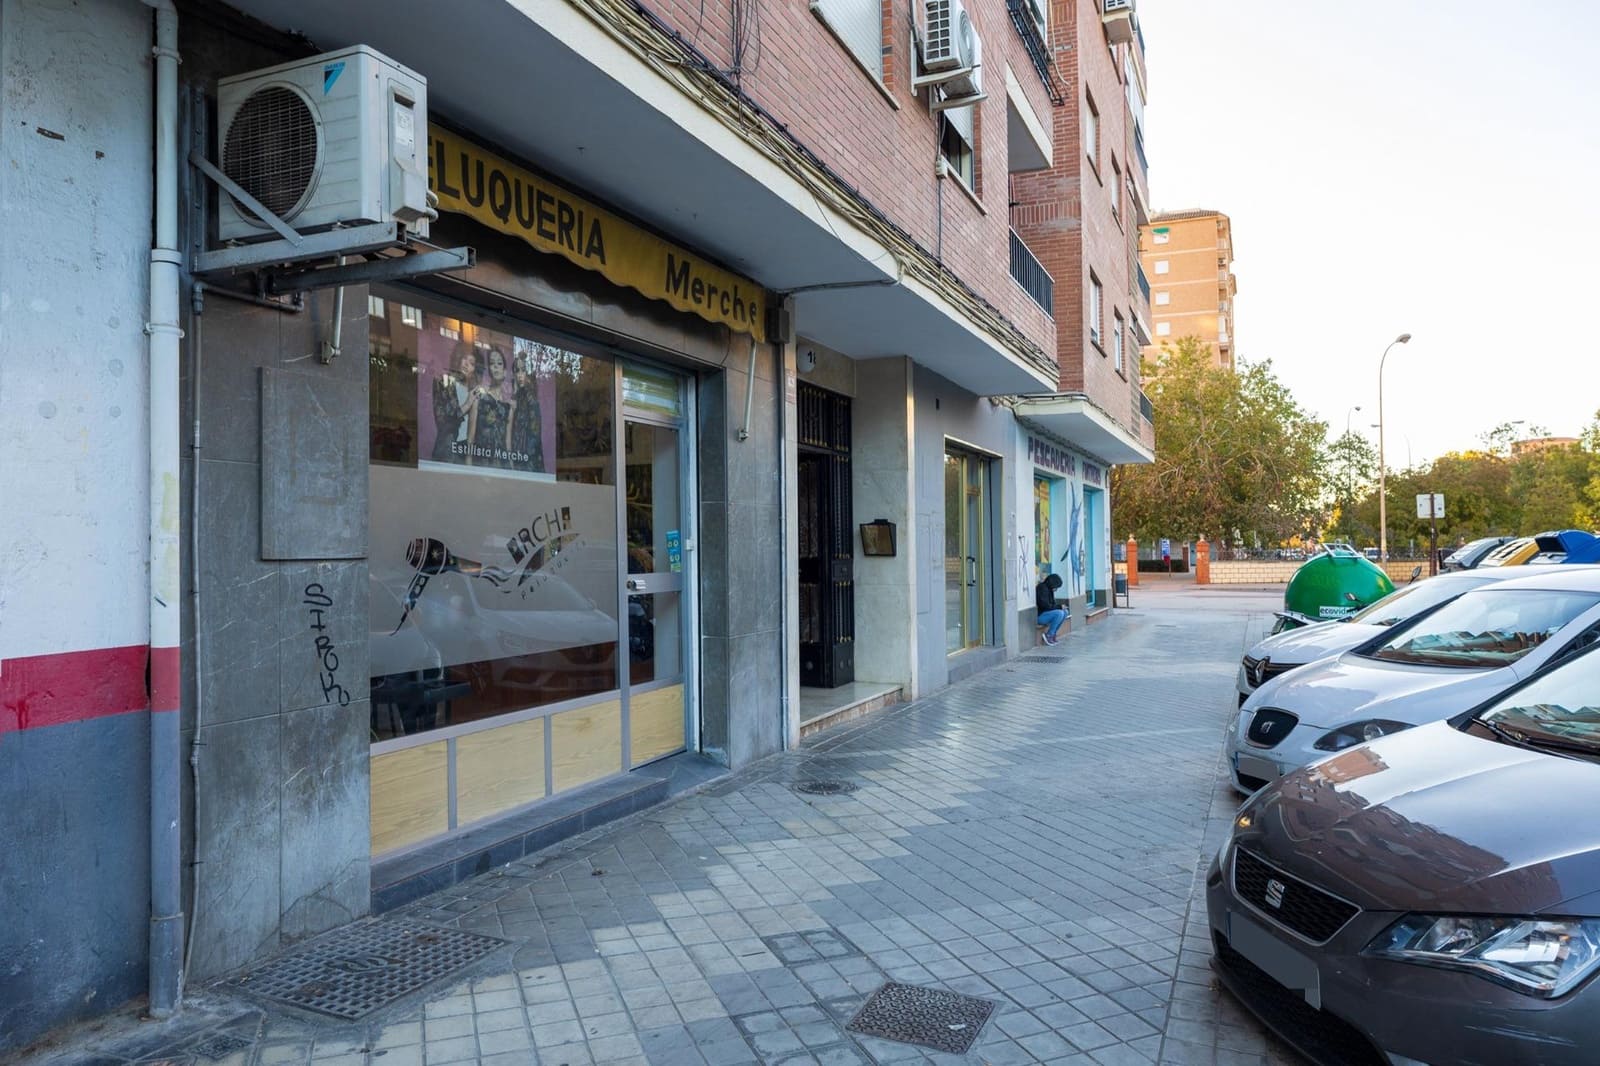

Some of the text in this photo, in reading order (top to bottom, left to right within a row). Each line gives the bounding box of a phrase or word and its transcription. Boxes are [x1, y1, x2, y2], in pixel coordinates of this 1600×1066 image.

[428, 136, 757, 325] LUQUERIA Merche
[451, 441, 529, 462] Estilista Merche
